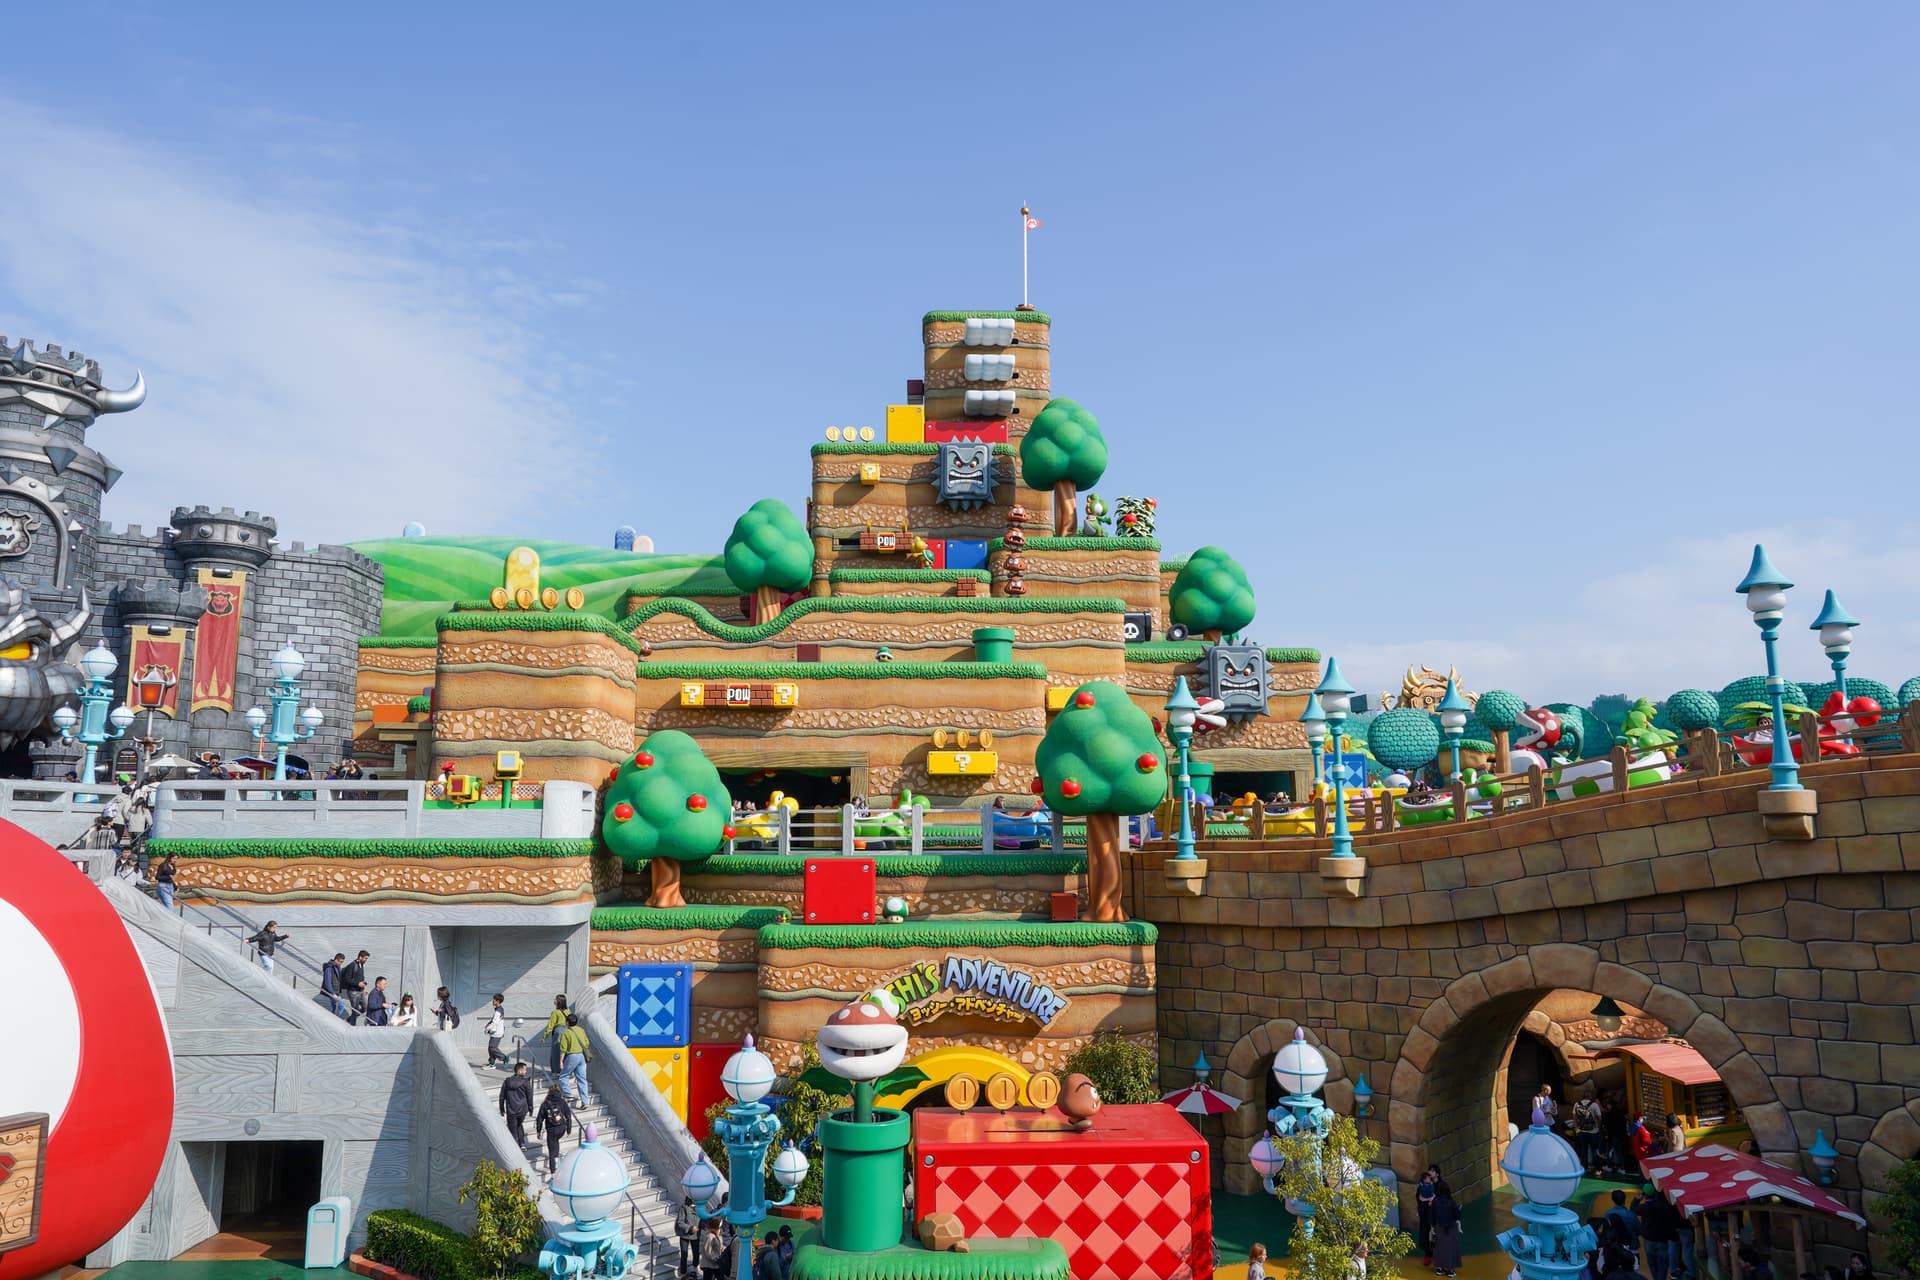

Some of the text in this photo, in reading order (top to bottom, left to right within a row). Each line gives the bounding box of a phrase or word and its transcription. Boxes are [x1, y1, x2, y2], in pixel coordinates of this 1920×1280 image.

[864, 465, 876, 478] ?
[877, 536, 896, 547] POW
[684, 685, 701, 704] ?
[727, 688, 751, 701] POW
[776, 685, 793, 704] ?
[953, 753, 971, 772] ?
[944, 957, 1067, 1025] ADVENTURE
